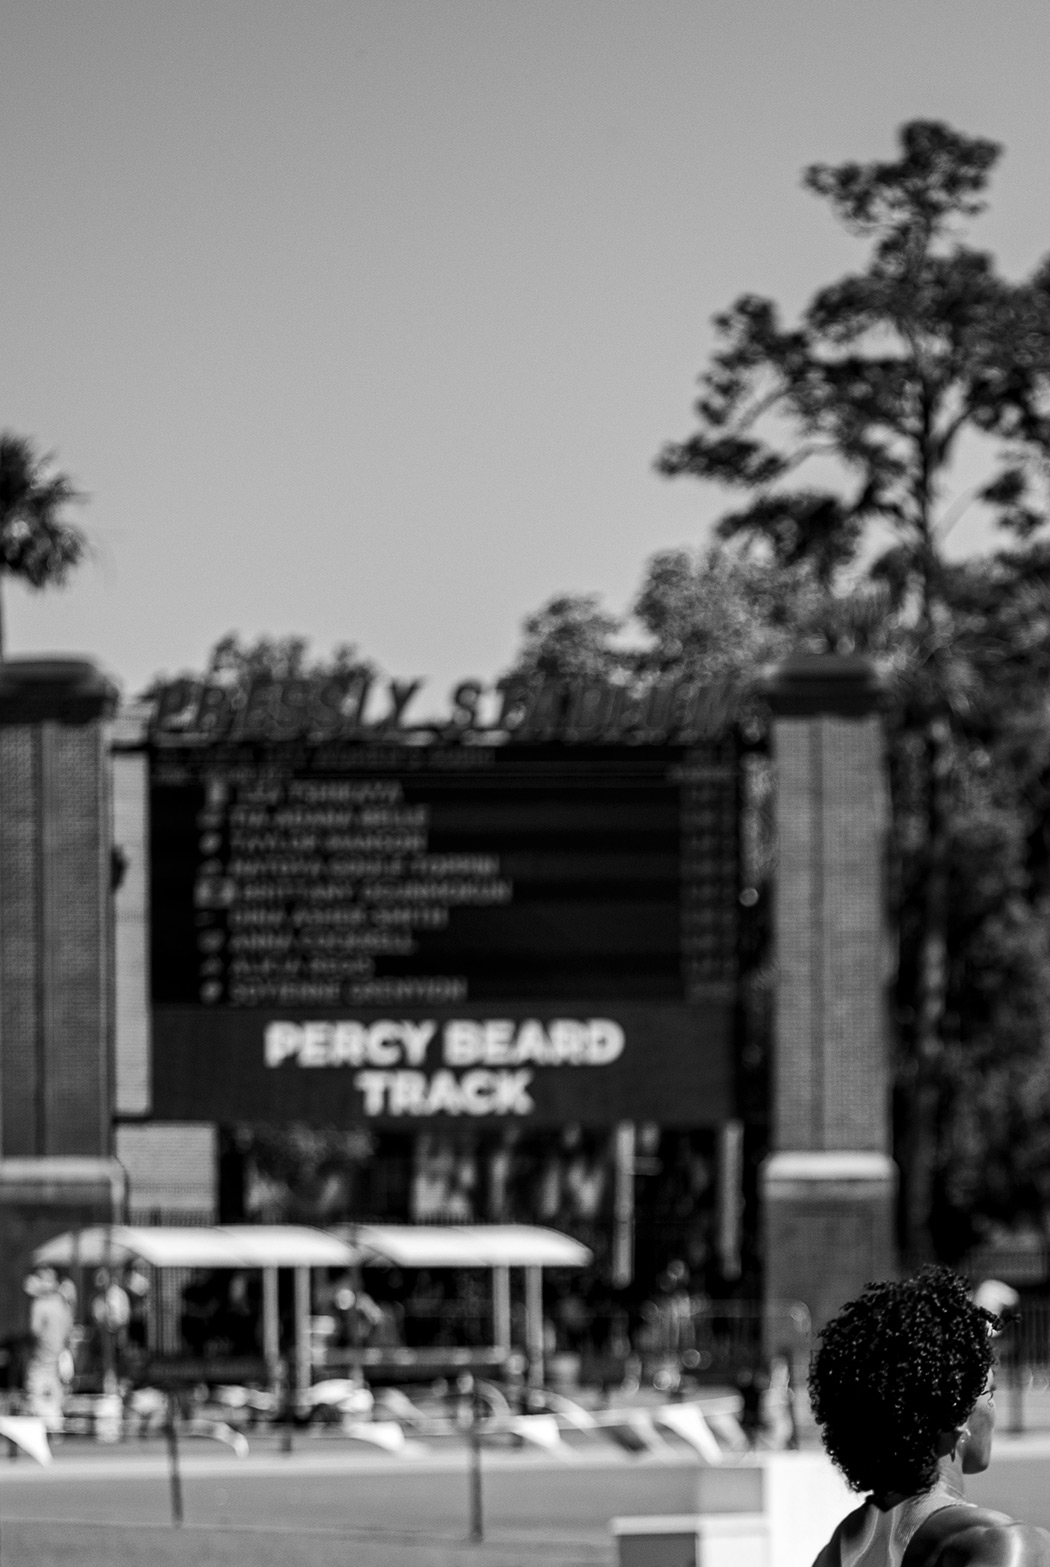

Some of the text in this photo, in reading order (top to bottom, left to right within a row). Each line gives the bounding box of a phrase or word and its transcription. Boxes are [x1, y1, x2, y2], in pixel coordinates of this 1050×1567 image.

[265, 1018, 625, 1067] PERCY BEARD
[357, 1070, 534, 1114] TRACK
